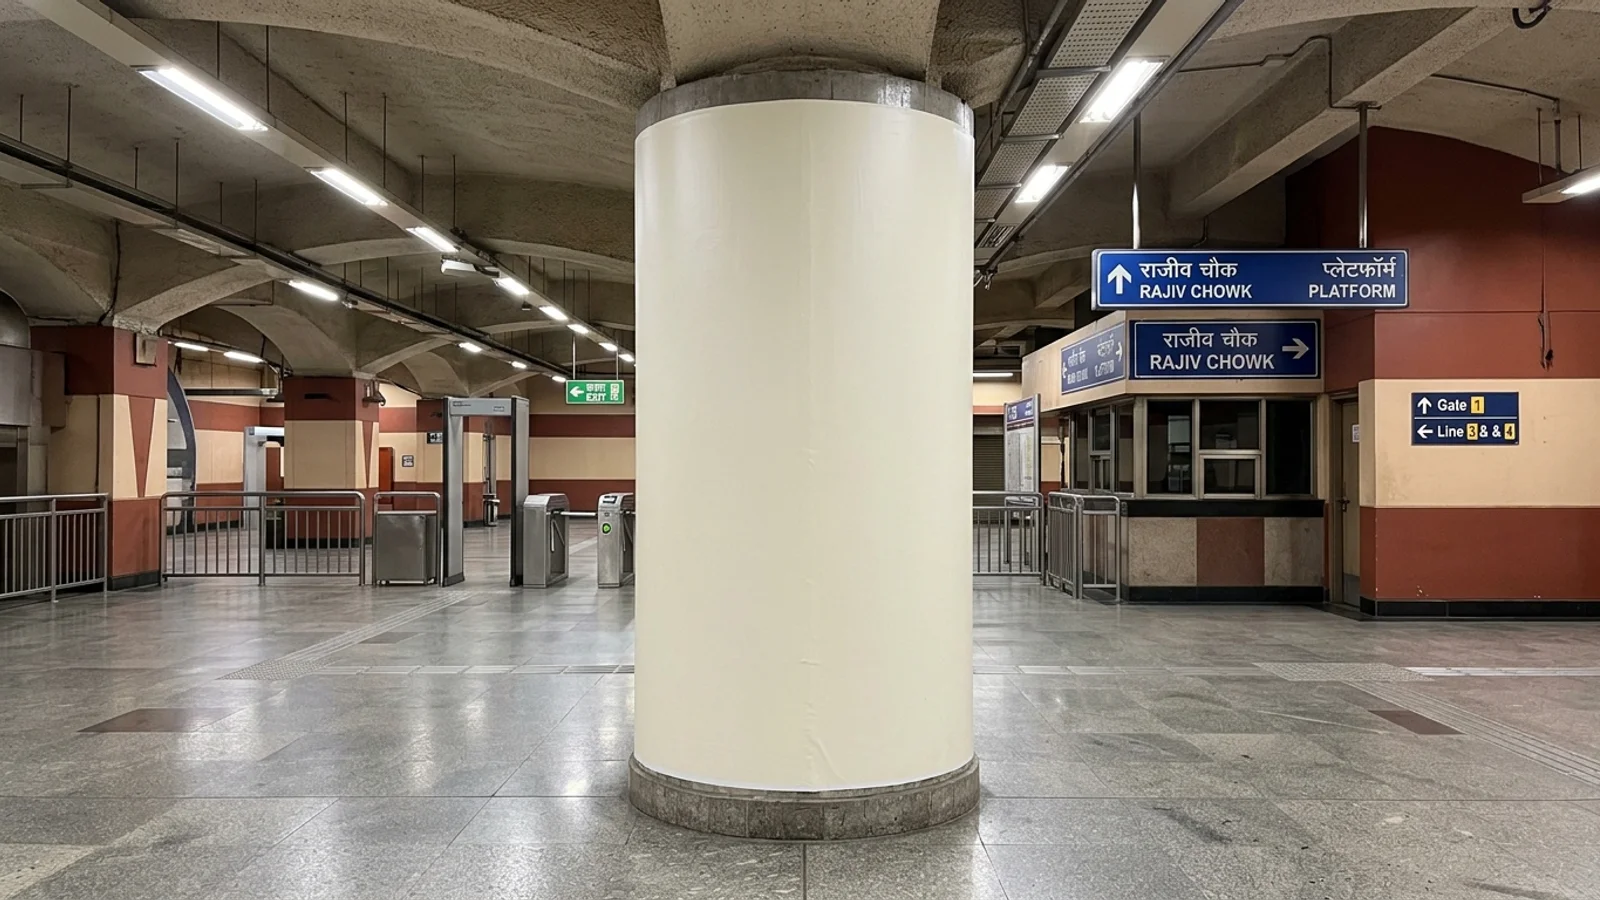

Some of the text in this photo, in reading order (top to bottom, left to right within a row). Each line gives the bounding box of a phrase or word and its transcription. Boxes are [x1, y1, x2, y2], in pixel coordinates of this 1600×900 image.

[1139, 257, 1239, 279] राजीव चौक
[1322, 256, 1397, 279] प्लेटफॉर्म
[1140, 284, 1253, 299] RAJIV CHOWK
[1308, 284, 1396, 299] PLATFORM
[1162, 327, 1258, 349] राजीव चौक
[1150, 354, 1275, 370] RAJIV CHOWK
[1437, 398, 1467, 412] Gate
[1437, 425, 1464, 438] Line
[1479, 424, 1488, 438] &
[1492, 424, 1502, 438] &
